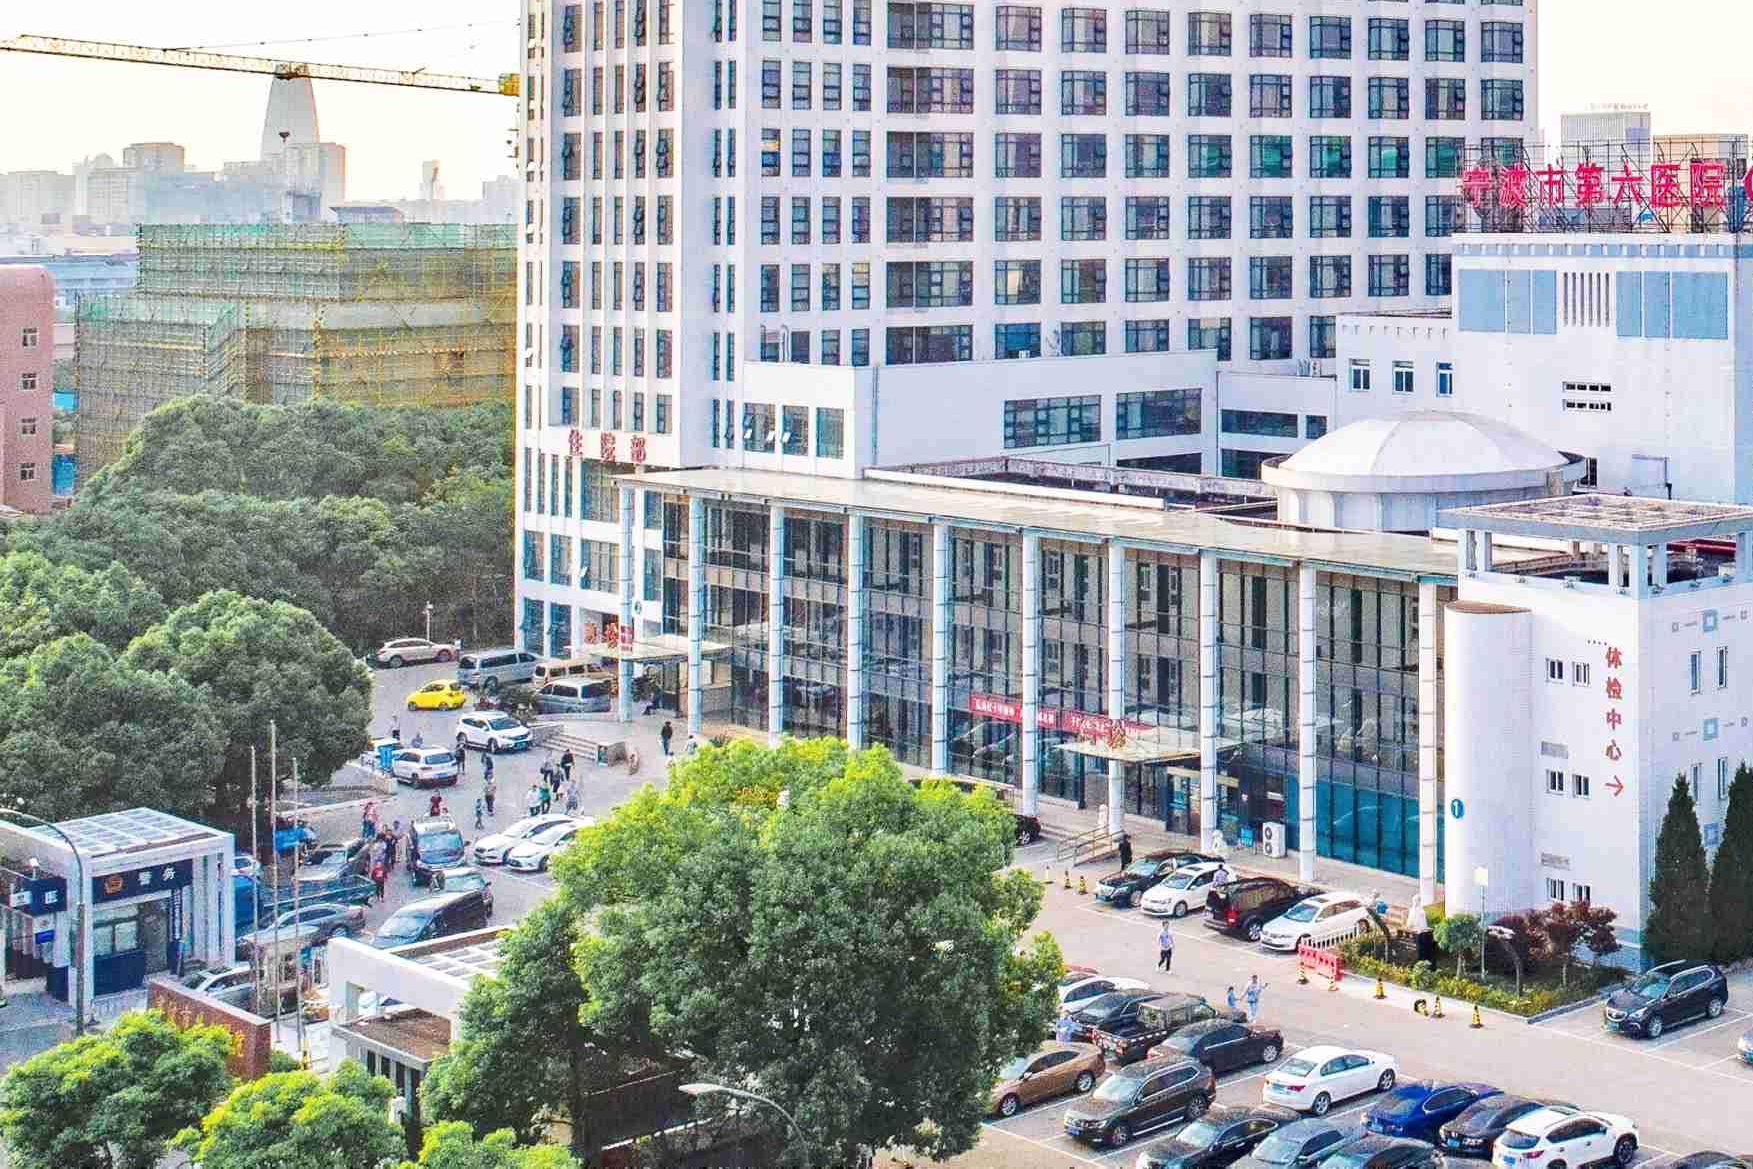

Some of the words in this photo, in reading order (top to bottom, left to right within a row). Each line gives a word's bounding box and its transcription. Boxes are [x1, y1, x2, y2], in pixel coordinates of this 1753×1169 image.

[1462, 159, 1726, 209] 宁波市第六医院
[1604, 645, 1623, 762] 体检中心
